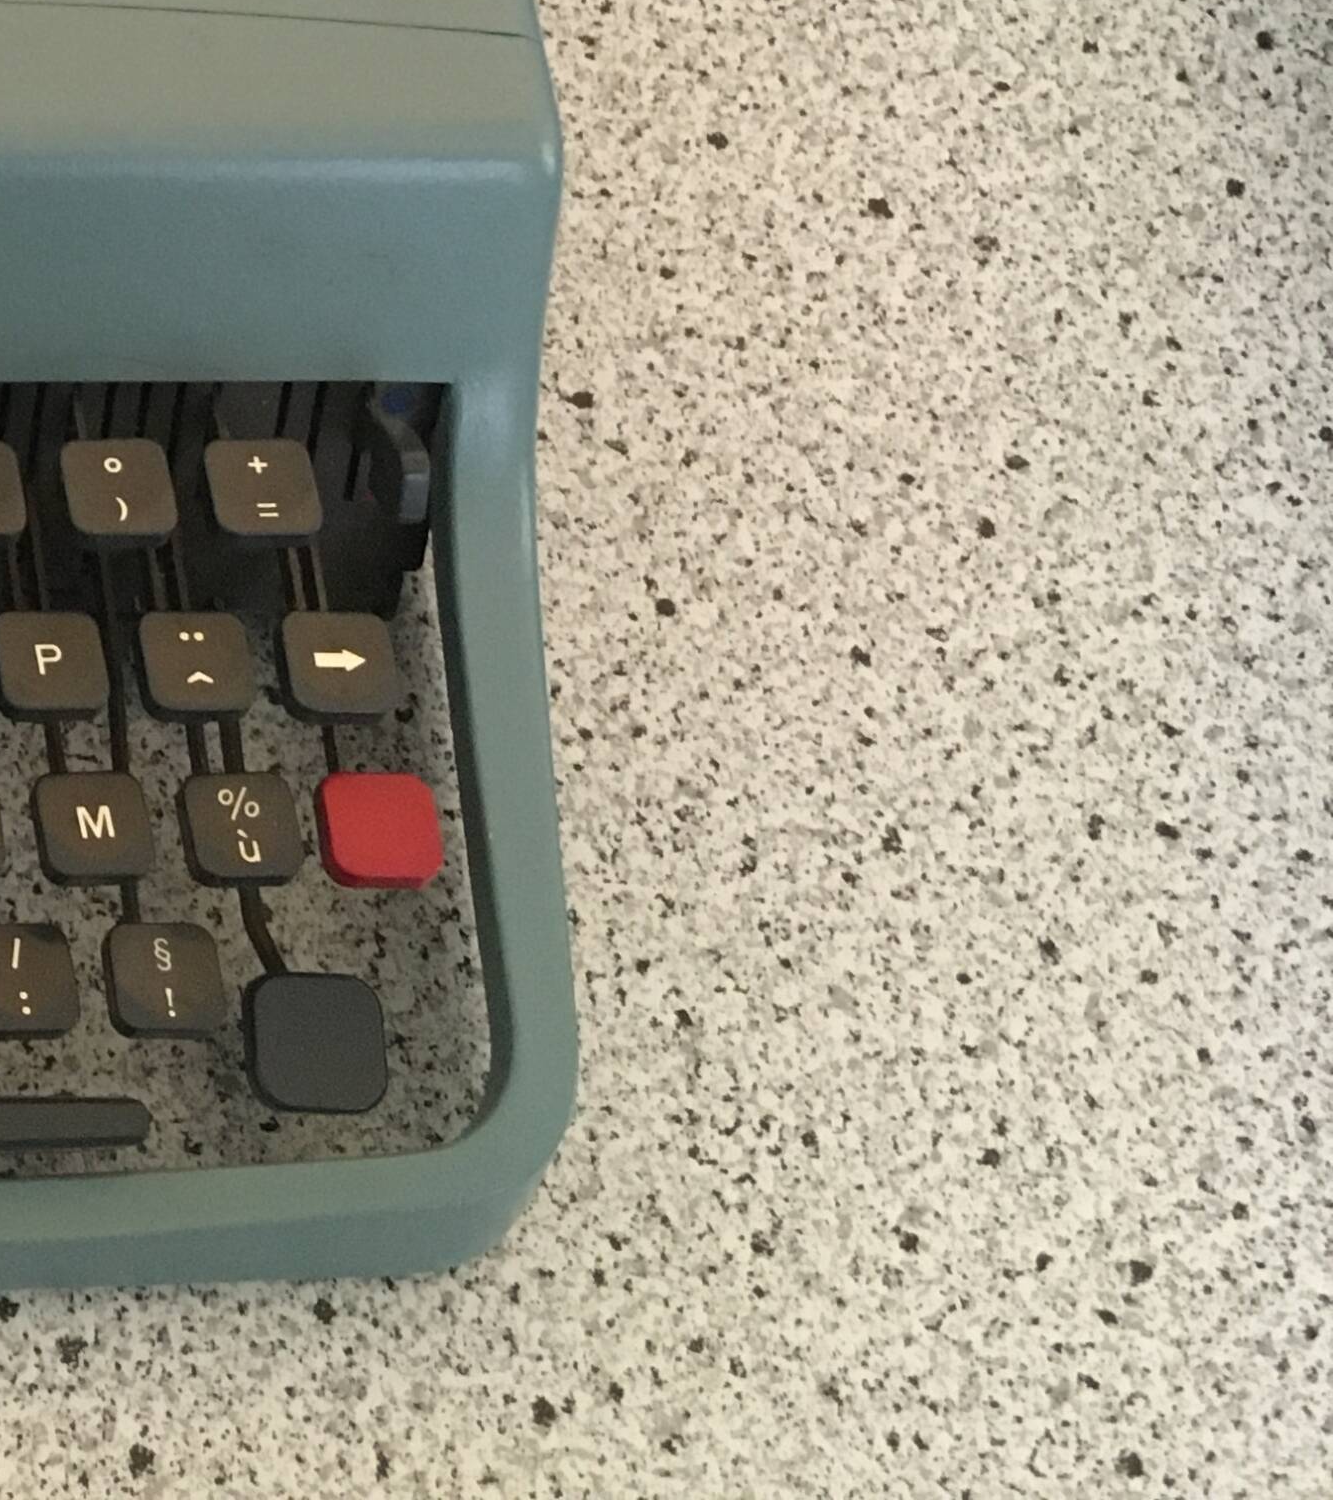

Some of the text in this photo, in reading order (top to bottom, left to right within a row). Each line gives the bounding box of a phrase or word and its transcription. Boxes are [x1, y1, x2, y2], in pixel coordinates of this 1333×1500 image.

[247, 456, 268, 474] +
[256, 502, 279, 518] =
[34, 643, 62, 675] P
[217, 786, 260, 821] %
[76, 805, 115, 839] M
[236, 828, 262, 863] ù
[153, 938, 172, 972] §
[165, 987, 176, 1017] !
